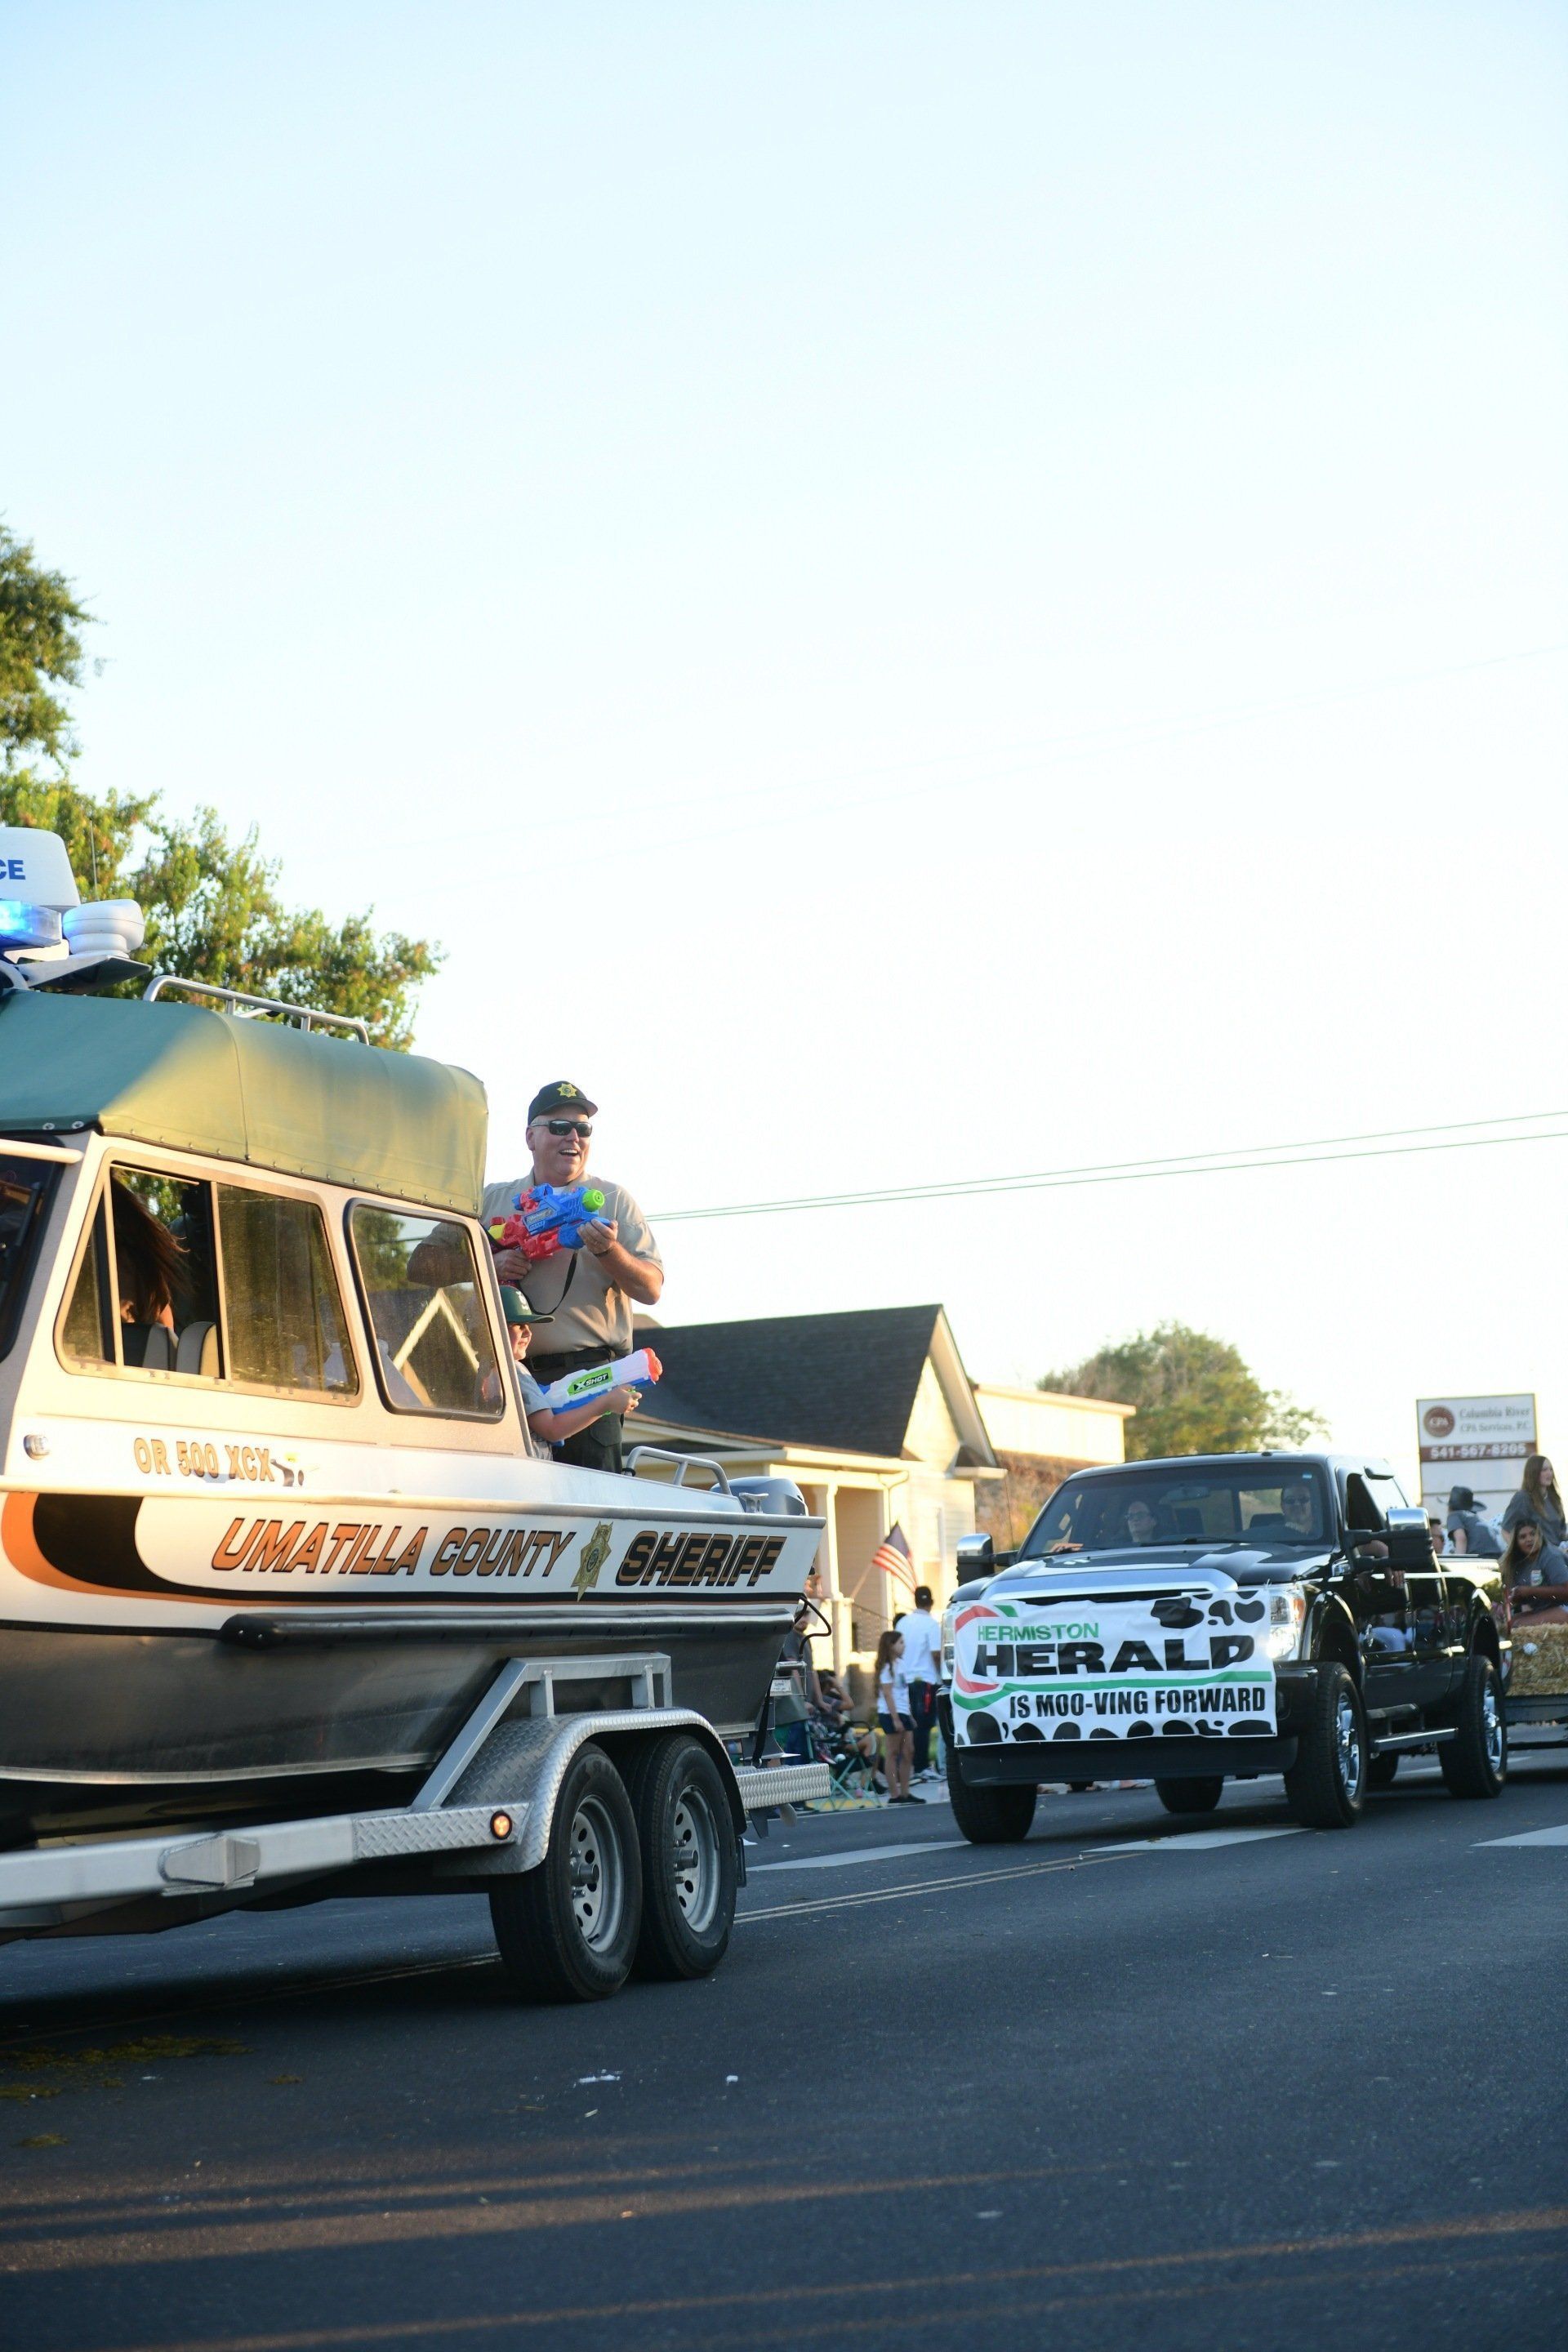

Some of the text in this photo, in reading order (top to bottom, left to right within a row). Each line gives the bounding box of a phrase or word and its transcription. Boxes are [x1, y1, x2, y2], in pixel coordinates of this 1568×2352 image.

[1429, 1417, 1450, 1428] CPA
[1459, 1405, 1530, 1419] Columbia River
[134, 1437, 275, 1481] OR 500 XCX
[212, 1517, 429, 1575] UMATILLA
[430, 1526, 577, 1577] COUNTY
[615, 1530, 787, 1587] SHERIFF
[978, 1623, 1099, 1642] HERMISTON
[973, 1634, 1255, 1677] HERALD
[1009, 1687, 1266, 1719] IS MOO-VING FORWARD
